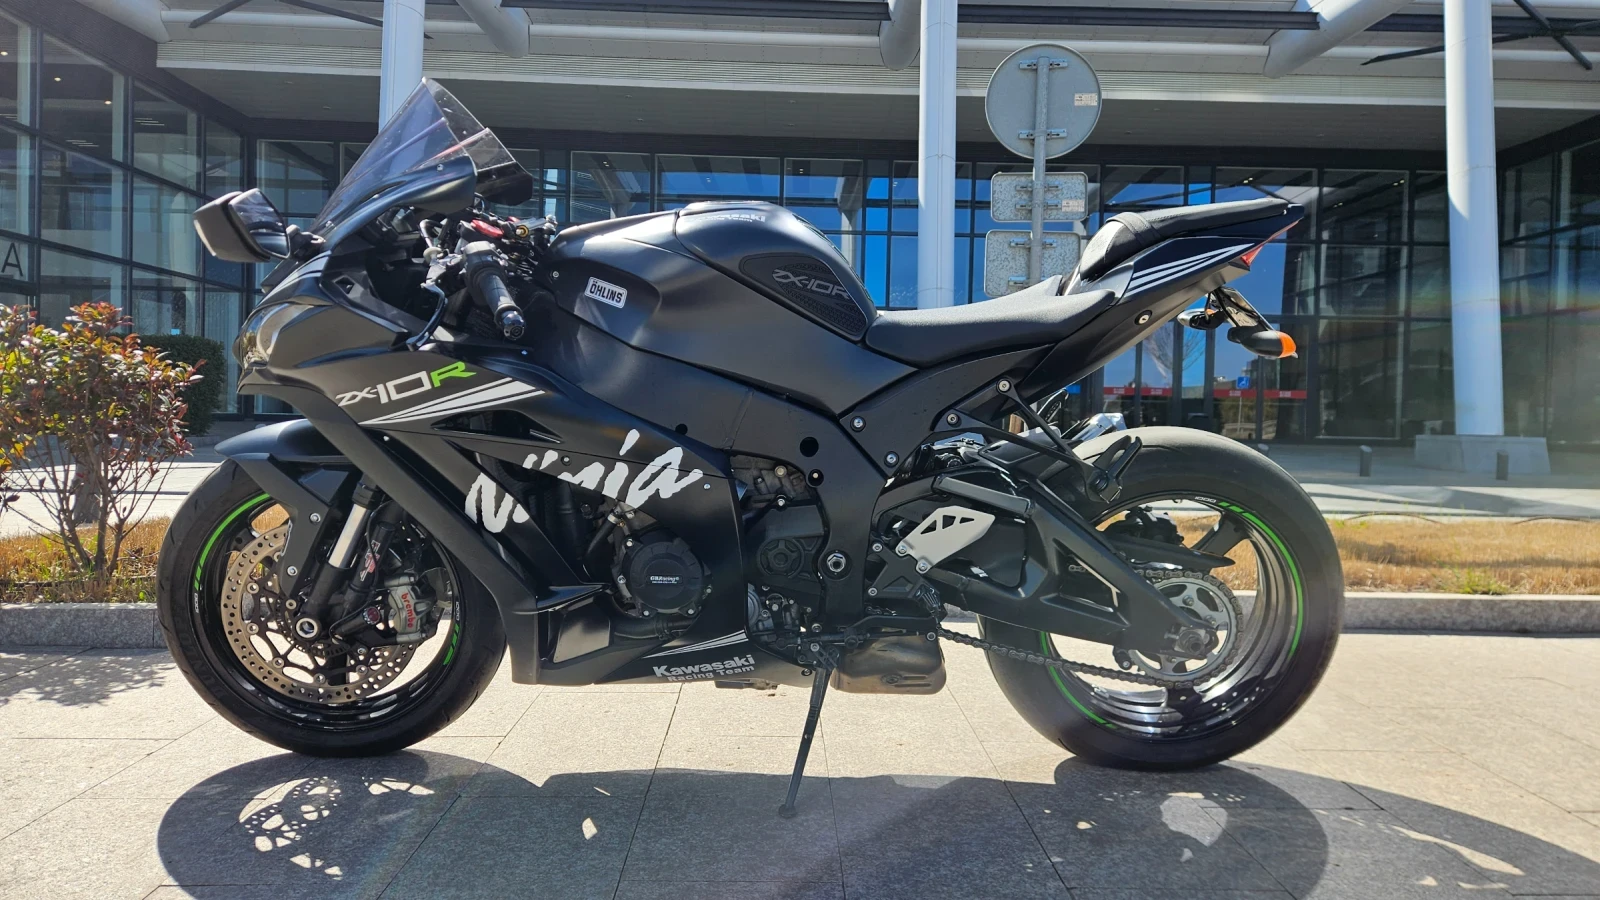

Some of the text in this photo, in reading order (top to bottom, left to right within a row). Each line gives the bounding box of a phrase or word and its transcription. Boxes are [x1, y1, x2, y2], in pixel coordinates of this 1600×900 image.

[1, 242, 23, 277] A
[589, 280, 623, 304] ÖHLINS
[772, 269, 852, 300] ZX-10R
[335, 361, 477, 407] ZX-10R
[401, 592, 417, 628] brembo
[653, 655, 755, 677] Kawasaki
[667, 666, 755, 682] Racing Team
